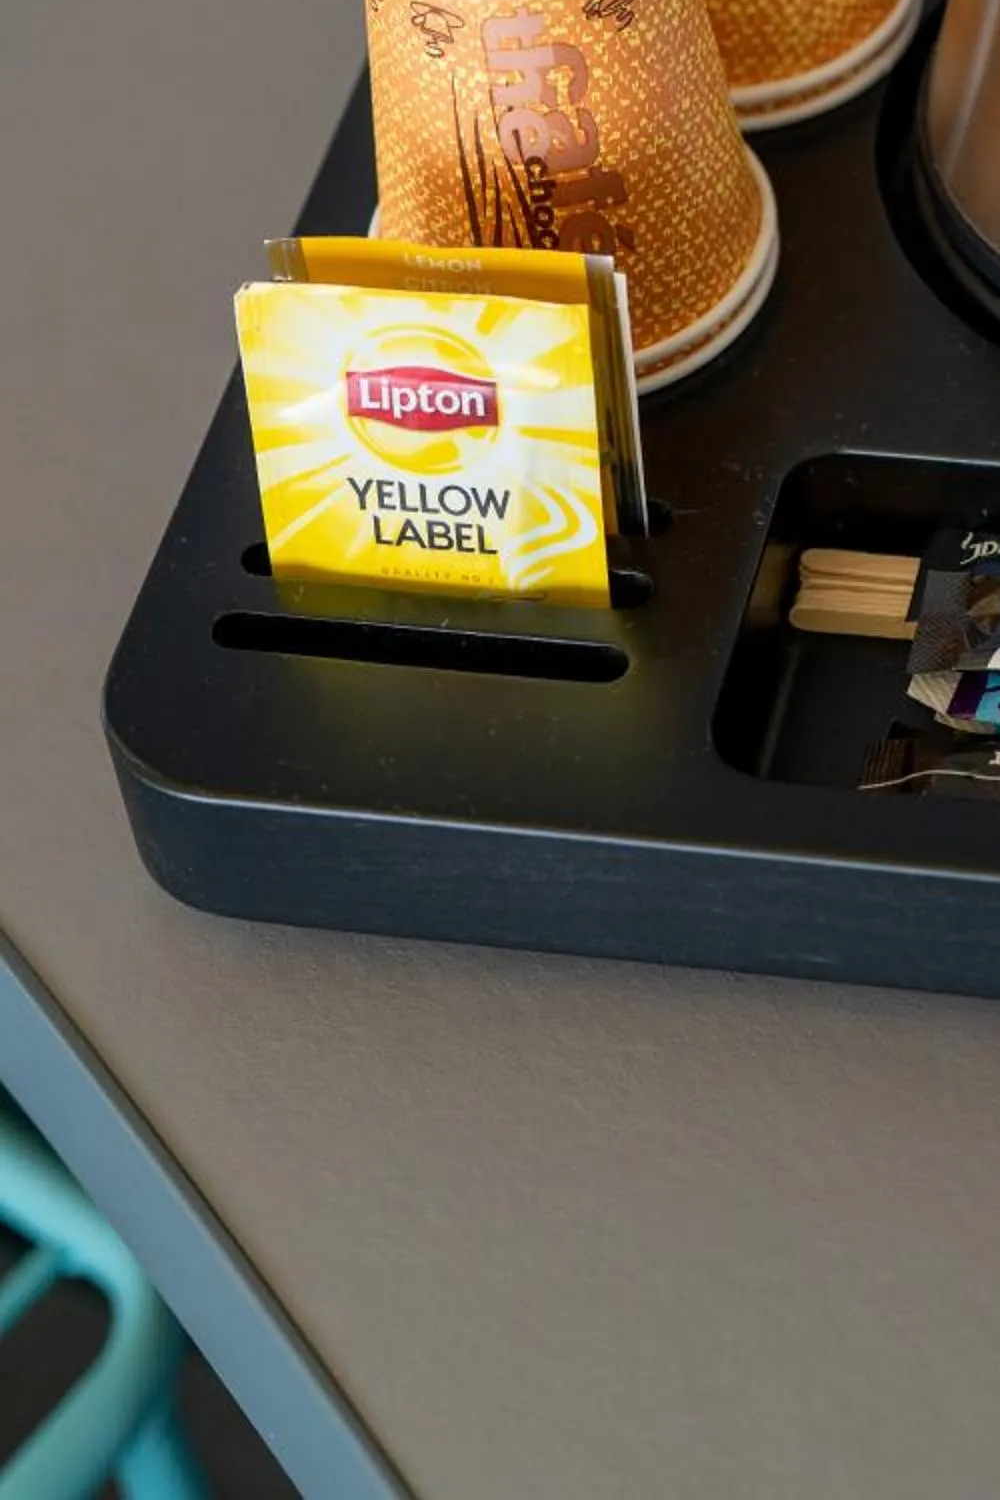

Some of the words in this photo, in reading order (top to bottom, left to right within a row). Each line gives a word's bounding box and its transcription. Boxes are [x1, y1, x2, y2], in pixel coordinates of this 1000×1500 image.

[404, 251, 482, 273] LEMON
[359, 379, 487, 420] Lipton
[347, 477, 511, 520] YELLOW
[373, 516, 498, 555] LABEL
